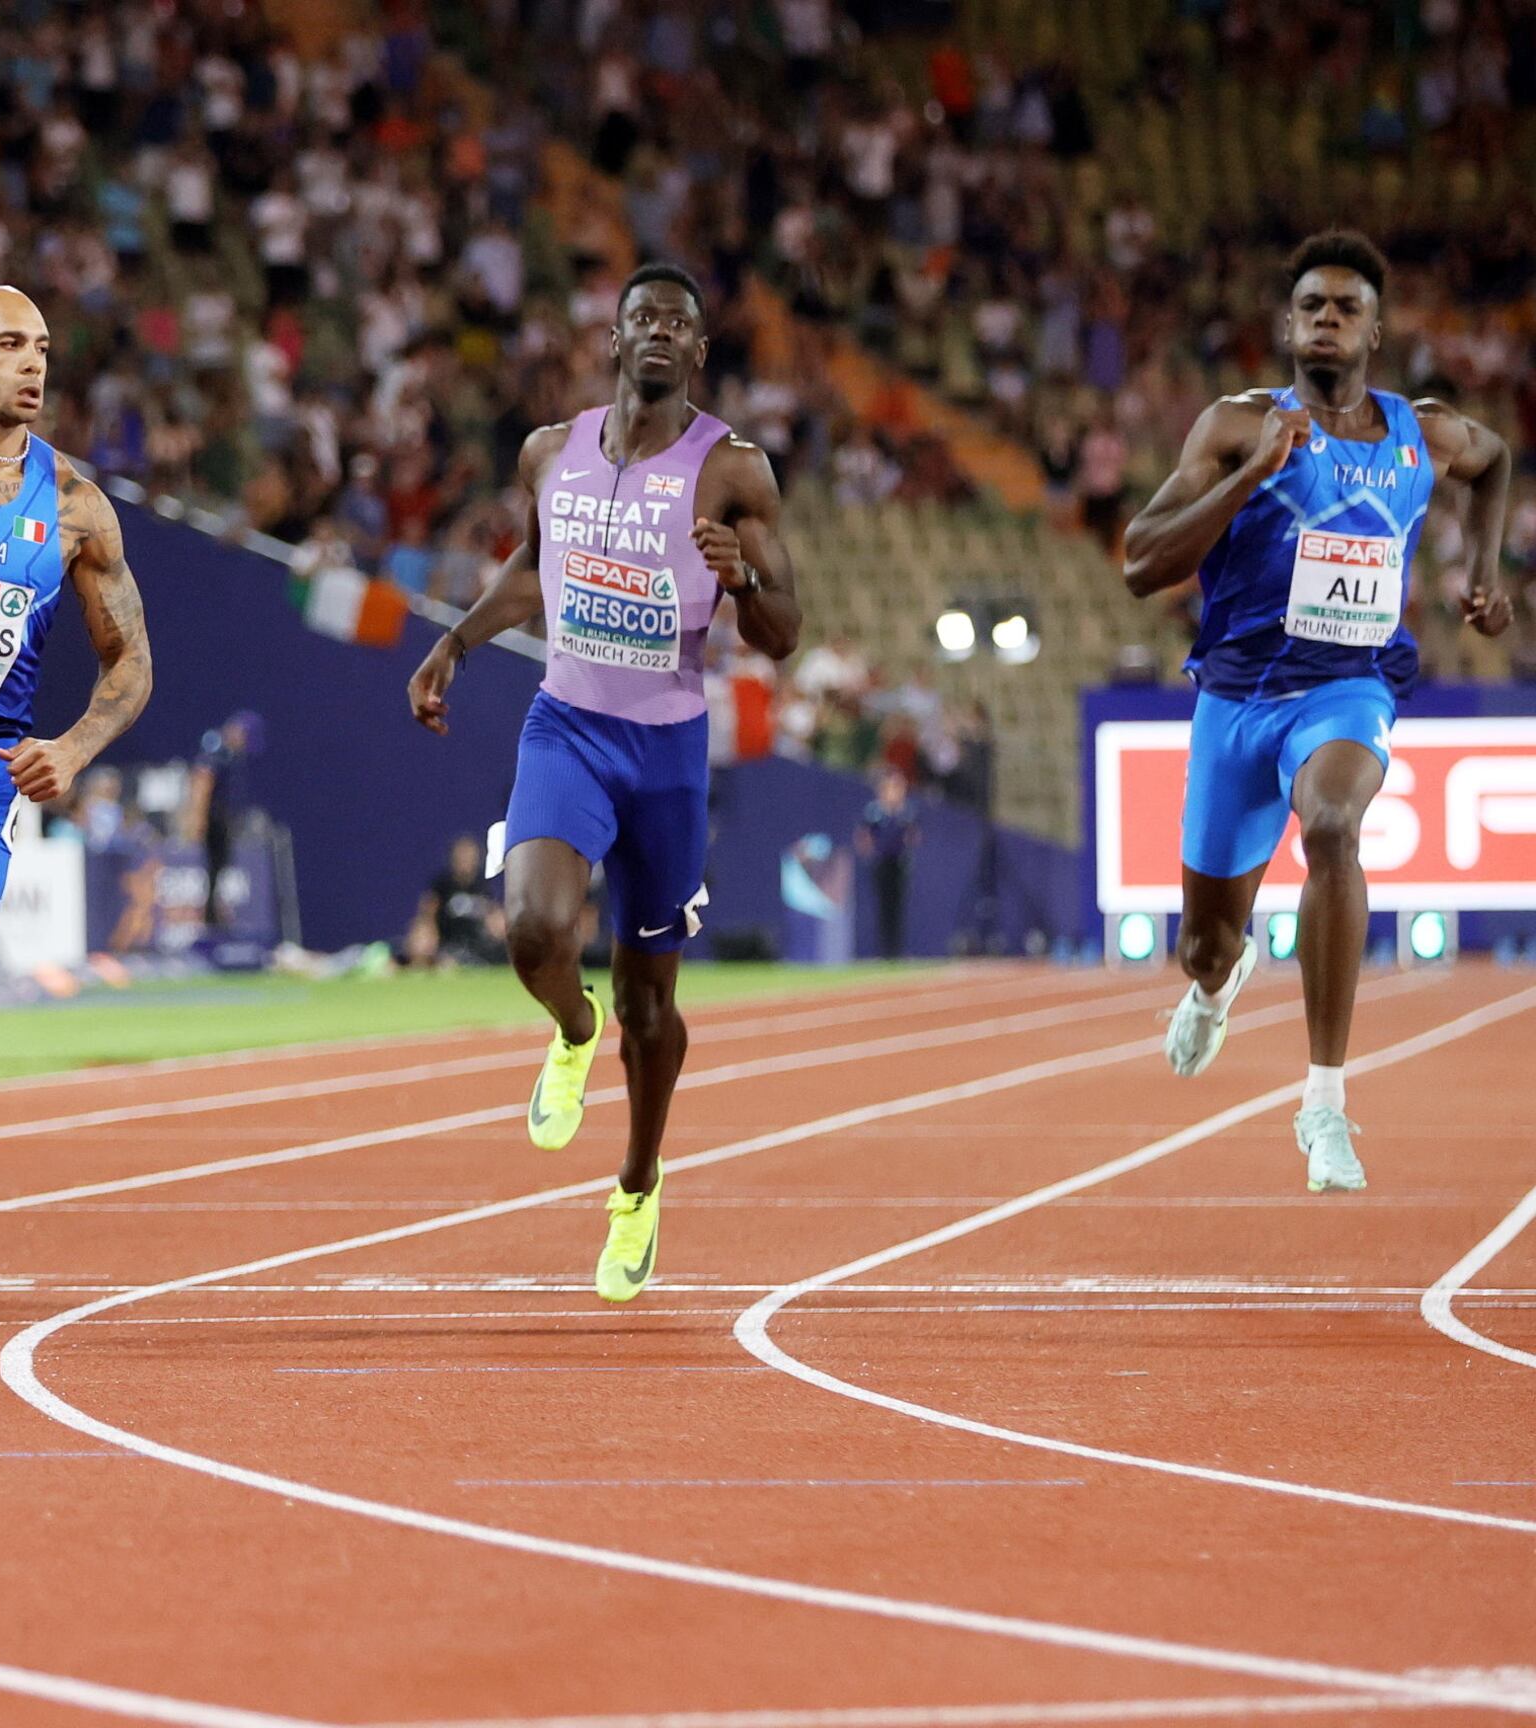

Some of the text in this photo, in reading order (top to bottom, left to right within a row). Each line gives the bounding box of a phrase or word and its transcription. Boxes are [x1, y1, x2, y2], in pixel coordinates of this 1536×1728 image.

[1333, 463, 1397, 489] ITALIA
[550, 490, 671, 526] GREAT
[549, 517, 666, 555] BRITAIN
[1302, 536, 1384, 565] SPAR
[566, 555, 649, 593] SPAR
[1326, 576, 1378, 605] ALI
[561, 586, 677, 636] PRESCOD
[587, 628, 610, 641] RUN
[612, 633, 647, 648] CLEAN
[1293, 616, 1358, 640] MUNICH
[561, 635, 671, 668] MUNICH 2022
